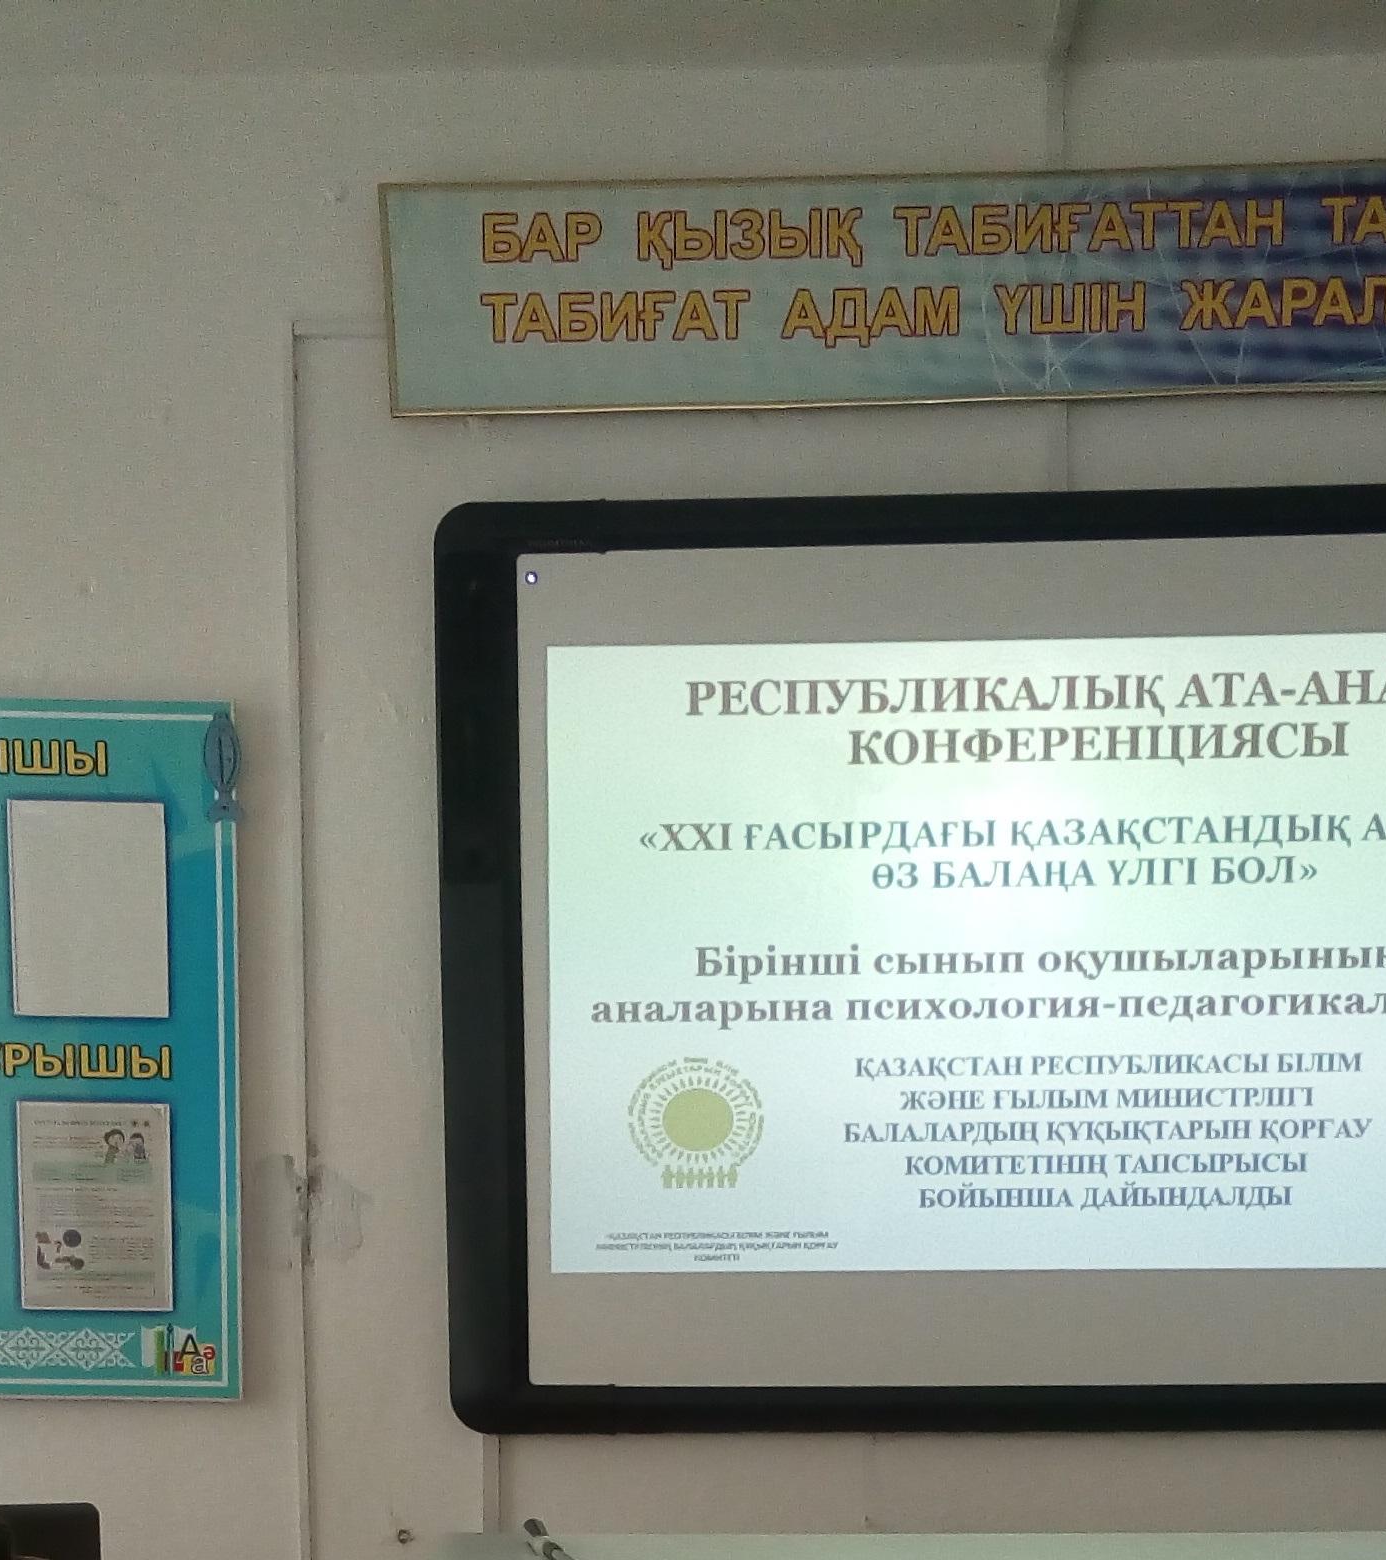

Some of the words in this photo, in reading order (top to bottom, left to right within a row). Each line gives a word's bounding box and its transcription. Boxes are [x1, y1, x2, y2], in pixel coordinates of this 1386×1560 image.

[481, 211, 603, 264] БАР
[637, 206, 864, 270] ҚЫЗЫҚ
[893, 198, 1285, 256] ТАБИҒАТТАН
[480, 289, 750, 343] ТАБИҒАТ
[781, 286, 962, 348] АДАМ
[994, 281, 1146, 334] ҮШІН
[686, 674, 1165, 717] РЕСПУБЛИКАЛЫҚ
[848, 721, 1350, 767] КОНФЕРЕНЦИЯСЫ
[744, 820, 995, 854] ҒАСЫРДАҒЫ
[1011, 814, 1351, 851] ҚАЗАҚСТАНДЫҚ
[872, 862, 918, 889] ӨЗ
[933, 860, 1096, 892] БАЛАҢА
[1108, 857, 1197, 886] ҮЛГІ
[1212, 856, 1317, 885] БОЛ»
[695, 943, 861, 985] Бірінші
[874, 952, 1024, 974] сынып
[591, 1000, 833, 1030] аналарына
[856, 1056, 1022, 1081] ҚАЗАҚСТАН
[1031, 1053, 1269, 1075] РЕСПУБЛИКАСЫ
[1277, 1052, 1362, 1073] БІЛІМ
[900, 1090, 984, 1110] ЖӘНЕ
[1117, 1087, 1313, 1108] МИНИСТРЛІГІ
[844, 1121, 1039, 1145] БАЛАЛАРДЫҢ
[905, 1154, 1108, 1178] КОМИТЕТІНІҢ
[1115, 1153, 1307, 1174] ТАПСЫРЫСЫ
[919, 1182, 1074, 1208] БОЙЫНША
[1080, 1181, 1292, 1211] ДАЙЫНДАЛДЫ
